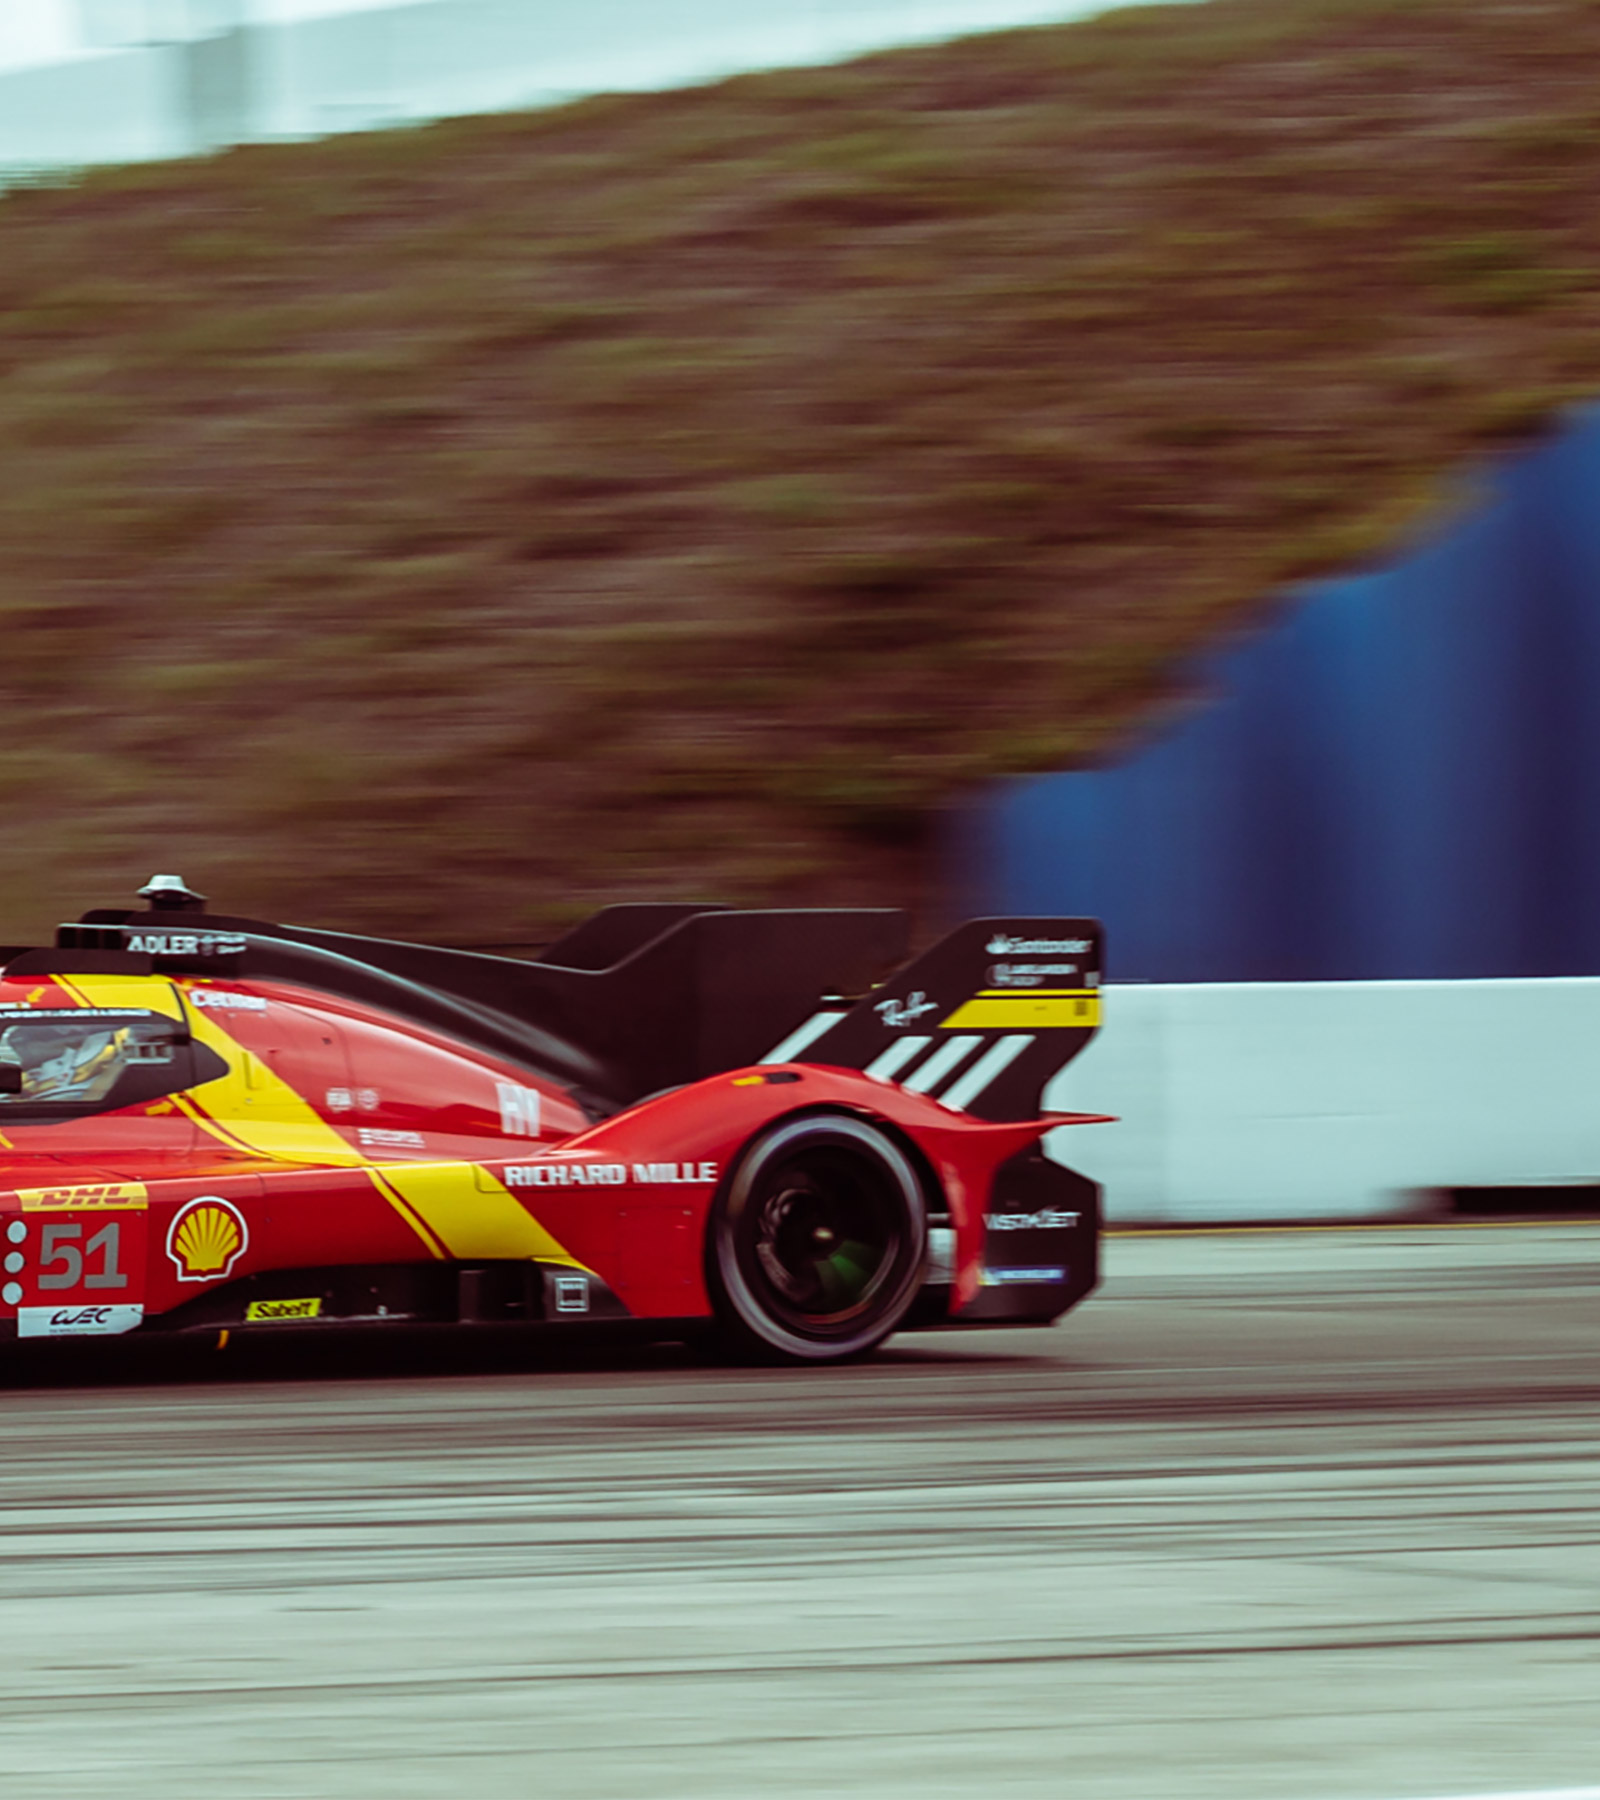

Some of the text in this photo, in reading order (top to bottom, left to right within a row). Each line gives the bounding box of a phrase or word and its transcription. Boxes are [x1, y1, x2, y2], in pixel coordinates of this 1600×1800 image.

[127, 935, 199, 955] ADLER
[504, 1162, 719, 1186] RICHARD MILLE
[38, 1187, 131, 1206] DHL
[38, 1222, 128, 1290] 51
[50, 1307, 113, 1325] WEC
